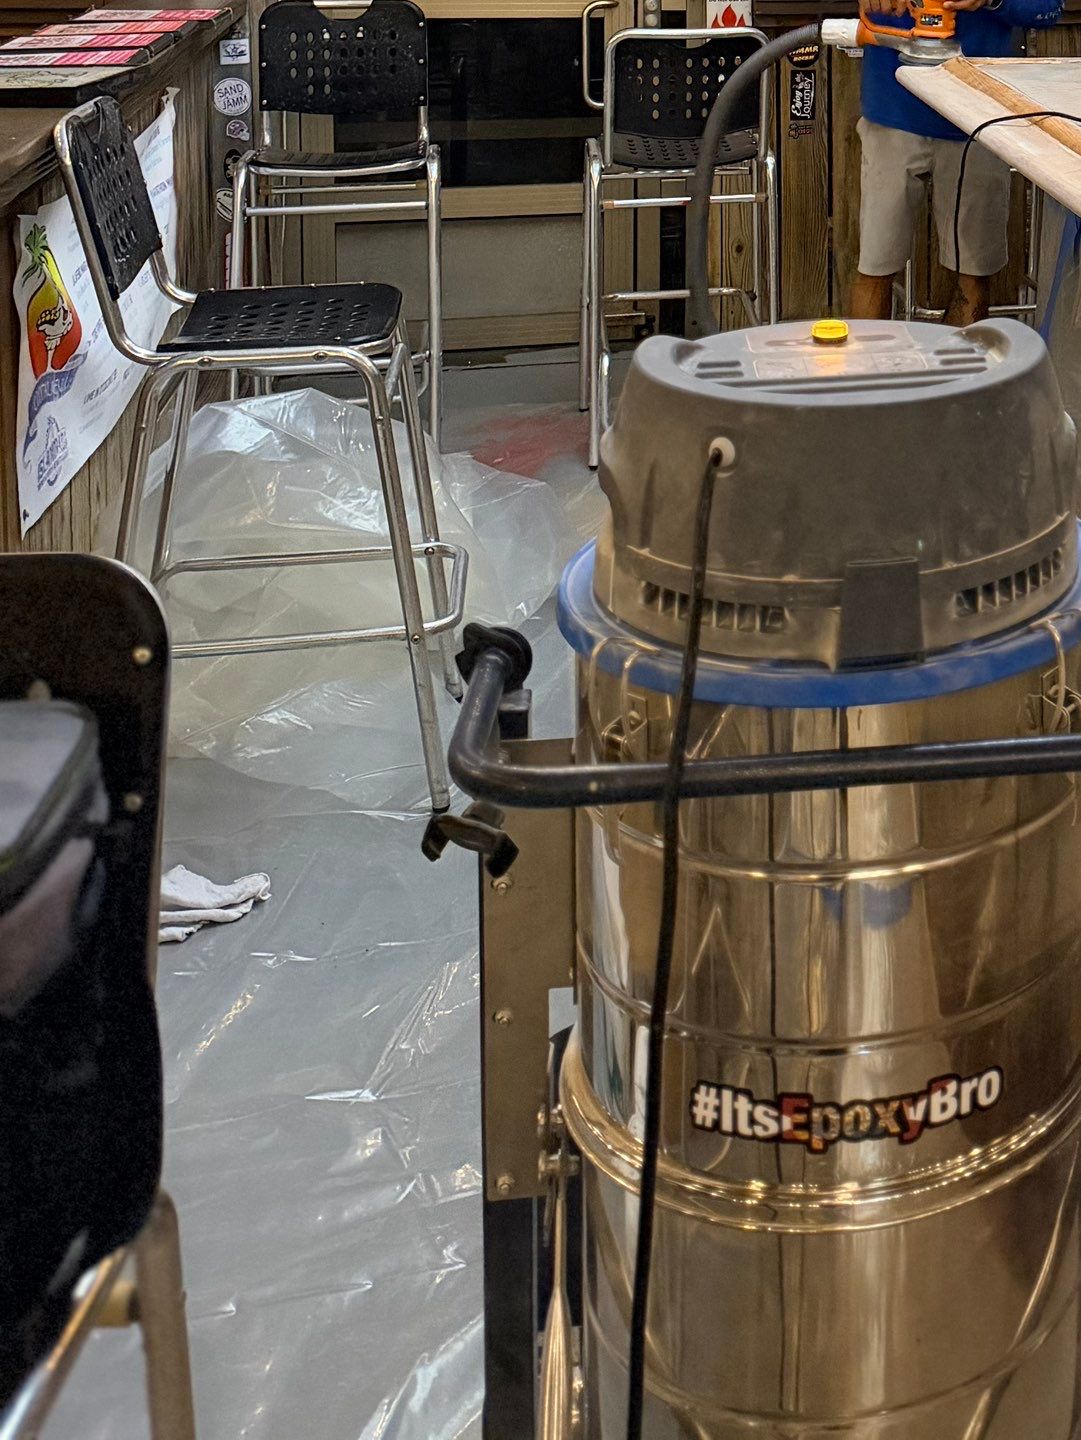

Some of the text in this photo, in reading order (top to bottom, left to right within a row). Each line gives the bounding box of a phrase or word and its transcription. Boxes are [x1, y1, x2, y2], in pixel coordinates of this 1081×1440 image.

[217, 83, 244, 98] SAND
[222, 95, 249, 110] JAMM
[792, 73, 814, 119] Enjoy Journey
[691, 1066, 1003, 1152] #ItsEpoxyBro
